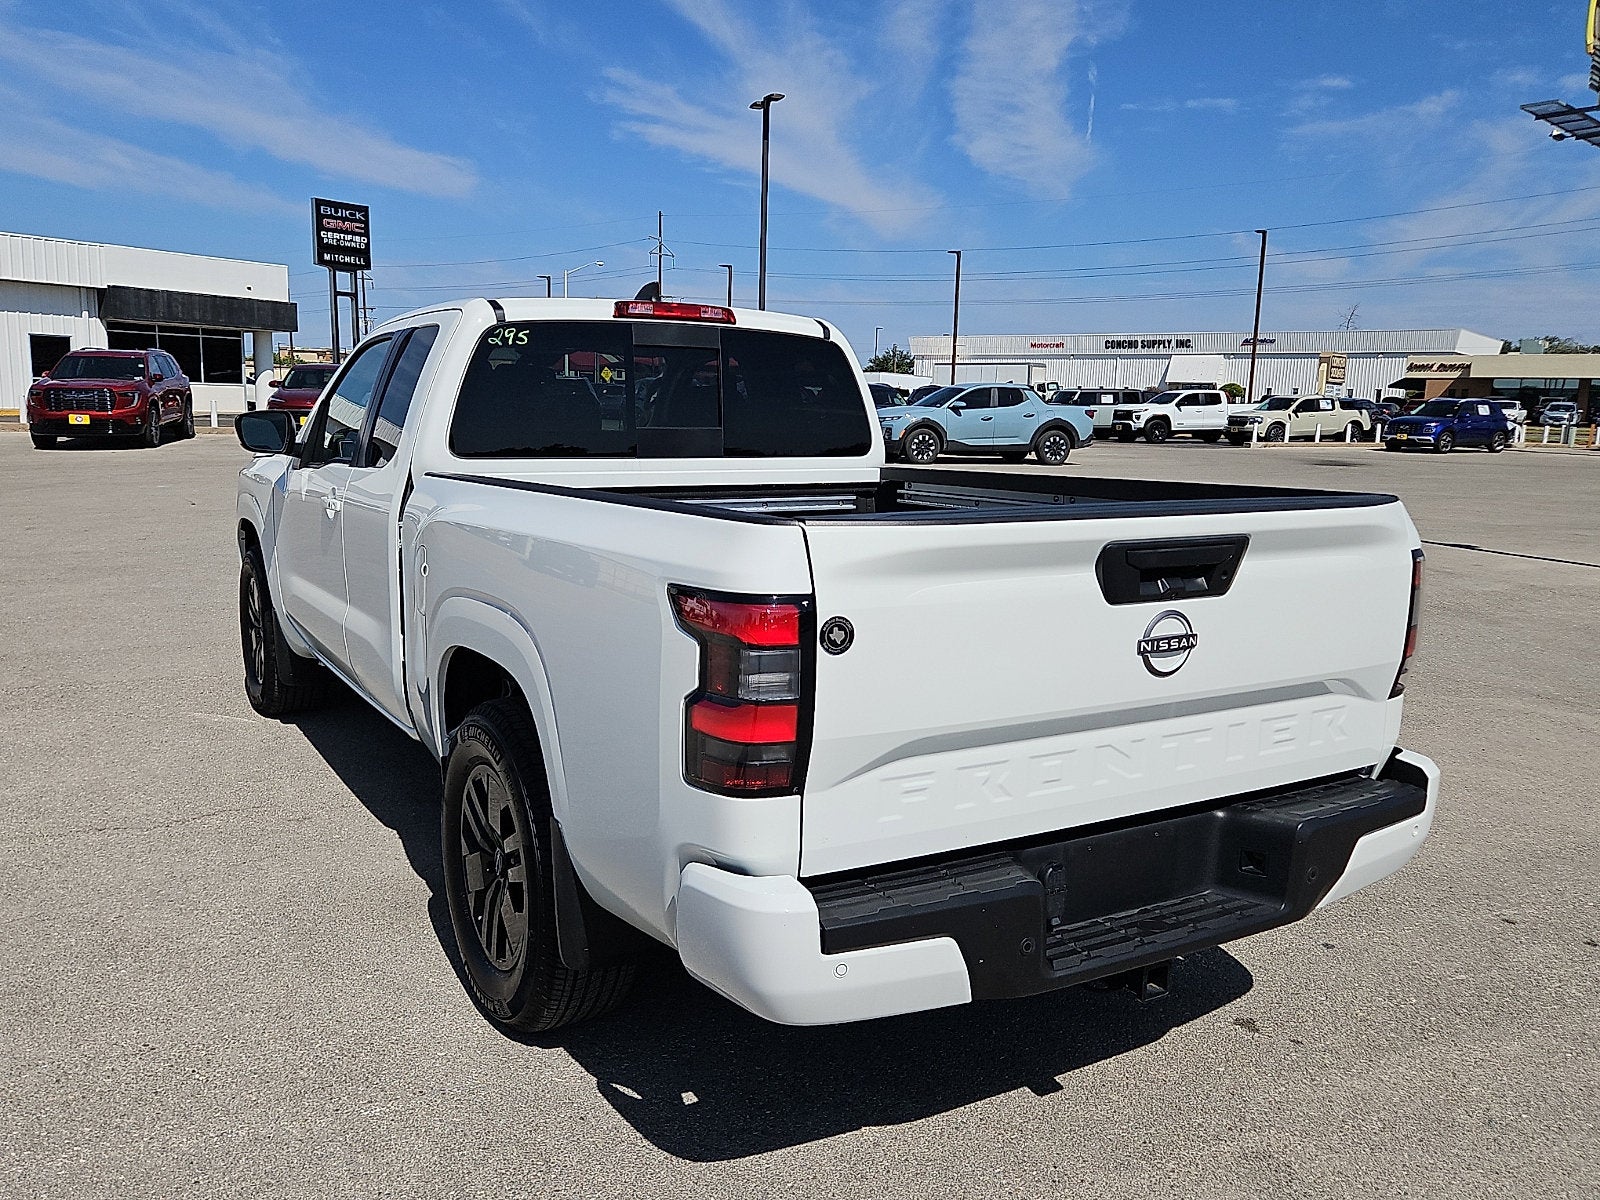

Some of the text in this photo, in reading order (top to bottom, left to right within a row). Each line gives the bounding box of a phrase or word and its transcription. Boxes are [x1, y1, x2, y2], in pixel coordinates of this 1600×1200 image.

[320, 206, 366, 220] BUICK
[322, 218, 365, 233] GMC
[320, 231, 368, 243] CERTIFIED
[323, 238, 366, 249] PRE-OWNED
[323, 253, 366, 265] MITCHELL
[488, 327, 530, 346] 295
[1030, 341, 1065, 349] Motorcraft
[1104, 338, 1194, 351] CONCHO SUPPLY, INC.
[1140, 636, 1197, 652] NISSAN
[469, 726, 501, 762] MICHELIN
[877, 705, 1350, 822] FRONTIER
